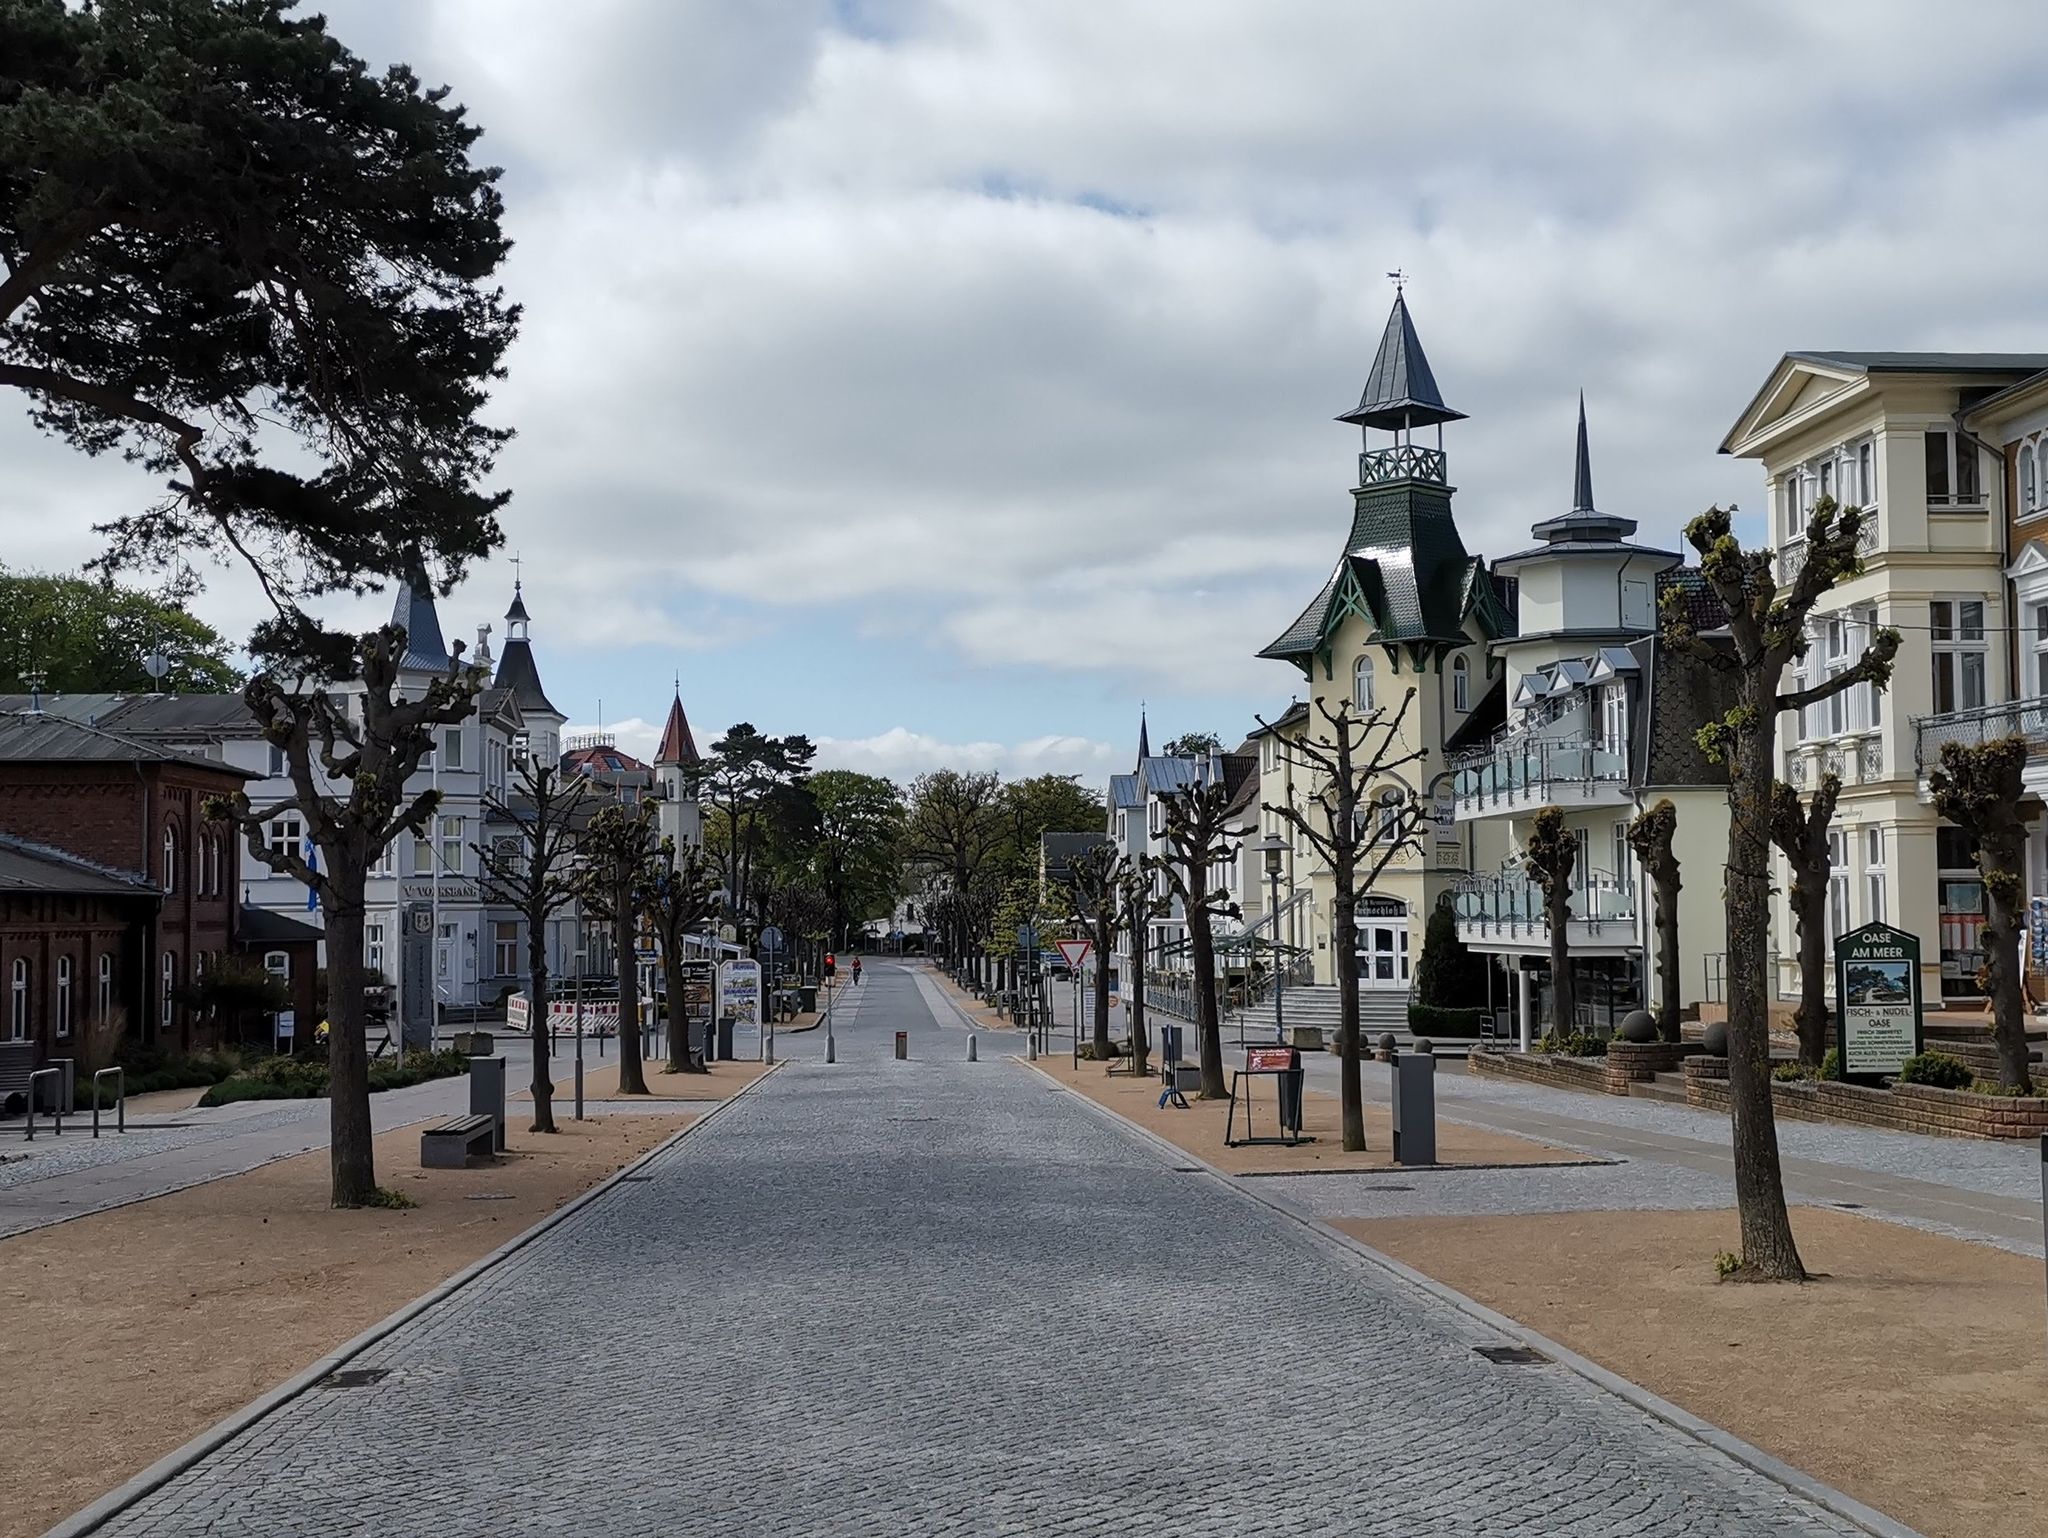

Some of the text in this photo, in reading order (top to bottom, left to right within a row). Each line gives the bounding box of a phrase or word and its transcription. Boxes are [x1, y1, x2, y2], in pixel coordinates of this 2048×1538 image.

[418, 886, 478, 897] VOKSBANK
[1862, 933, 1892, 943] OASE
[1851, 947, 1904, 958] AM MEER
[1868, 1018, 1891, 1027] OASE
